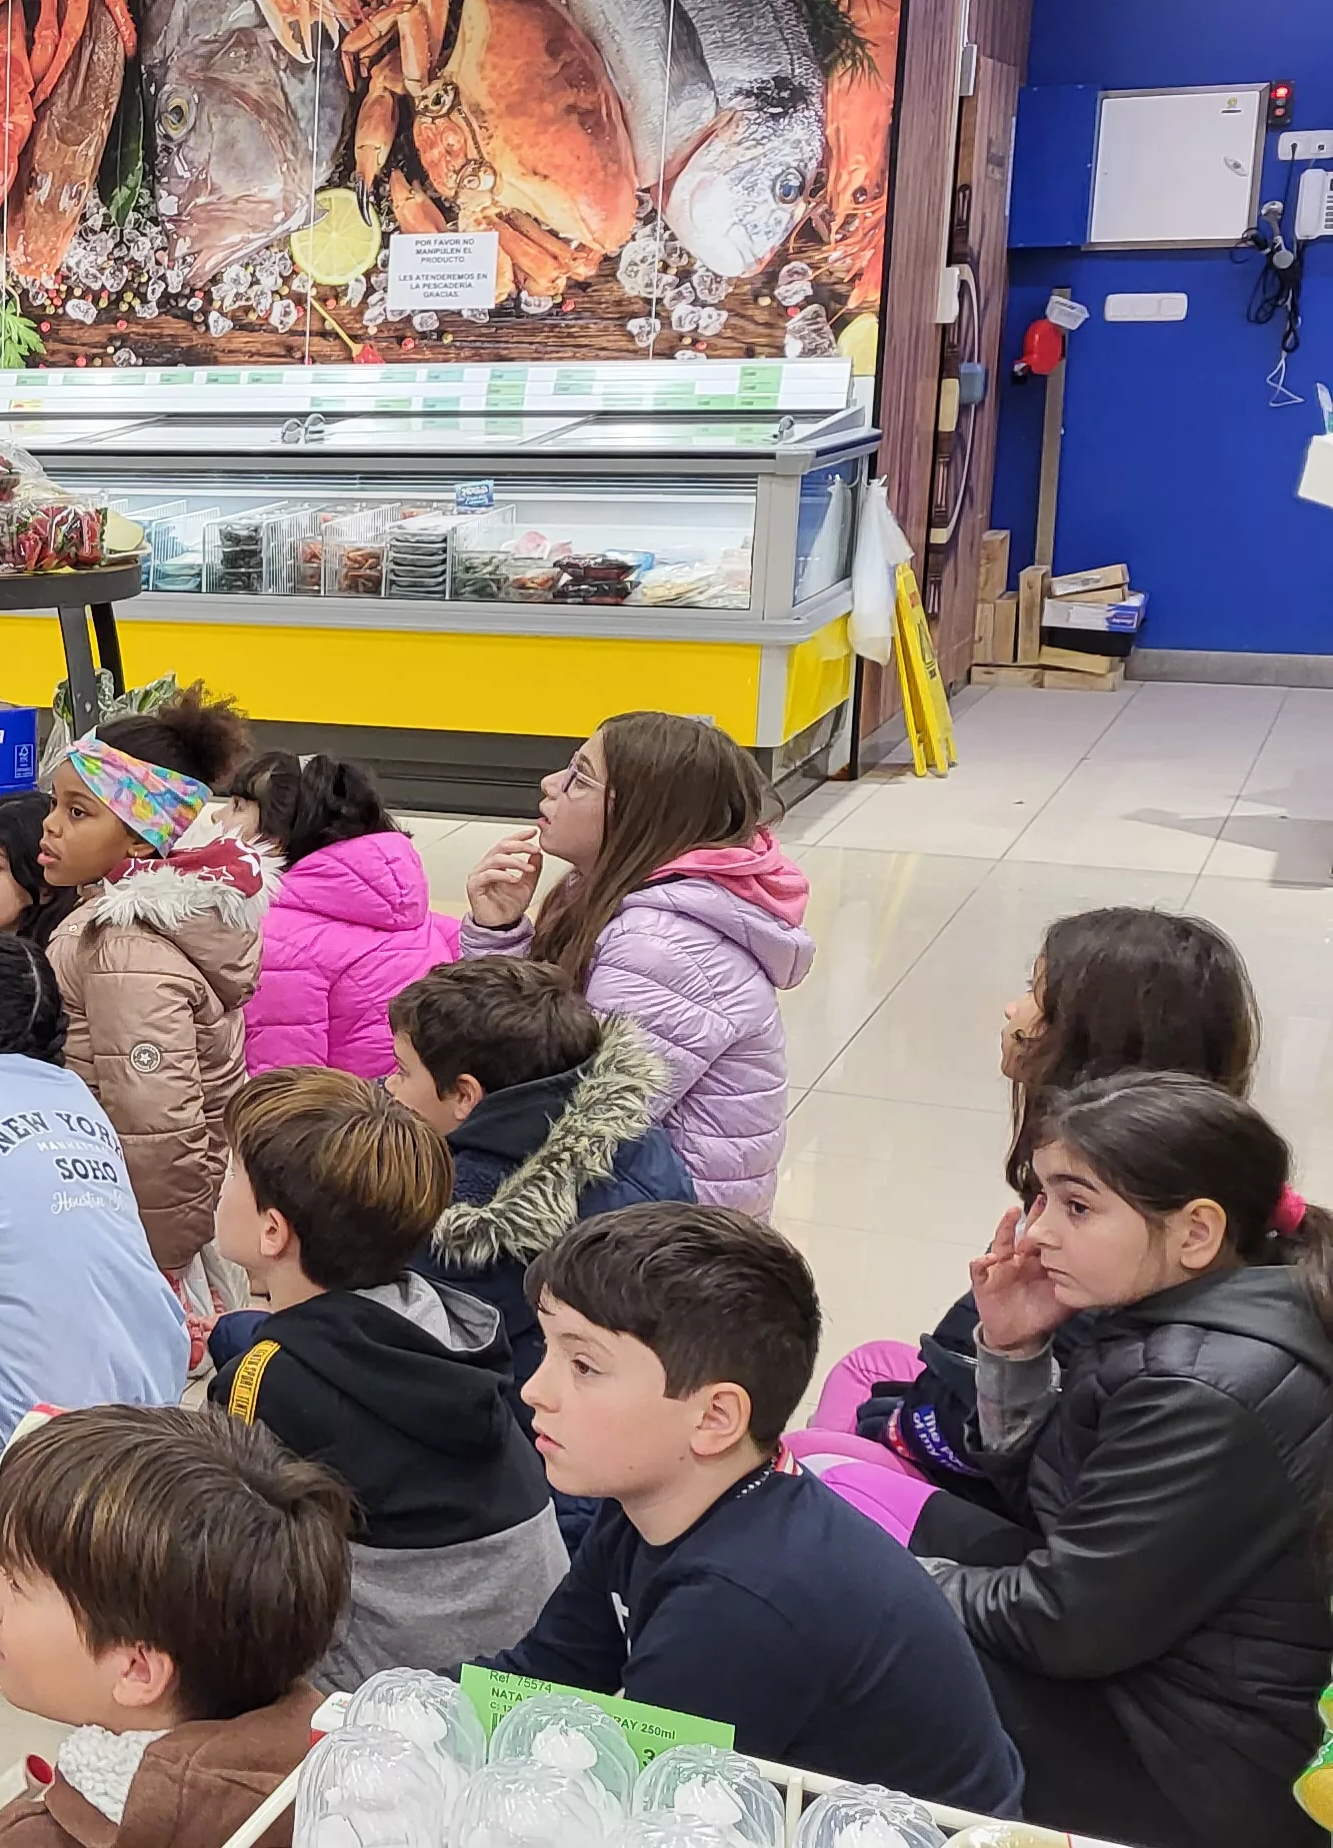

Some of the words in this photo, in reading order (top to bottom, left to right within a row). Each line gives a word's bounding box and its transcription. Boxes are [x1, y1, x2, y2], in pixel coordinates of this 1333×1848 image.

[415, 273, 475, 281] ATENDEREMOS
[54, 1156, 118, 1184] SOHO
[489, 1670, 510, 1684] Ref
[516, 1676, 552, 1693] 75574
[490, 1687, 523, 1703] NATA
[640, 1721, 676, 1740] 250ml
